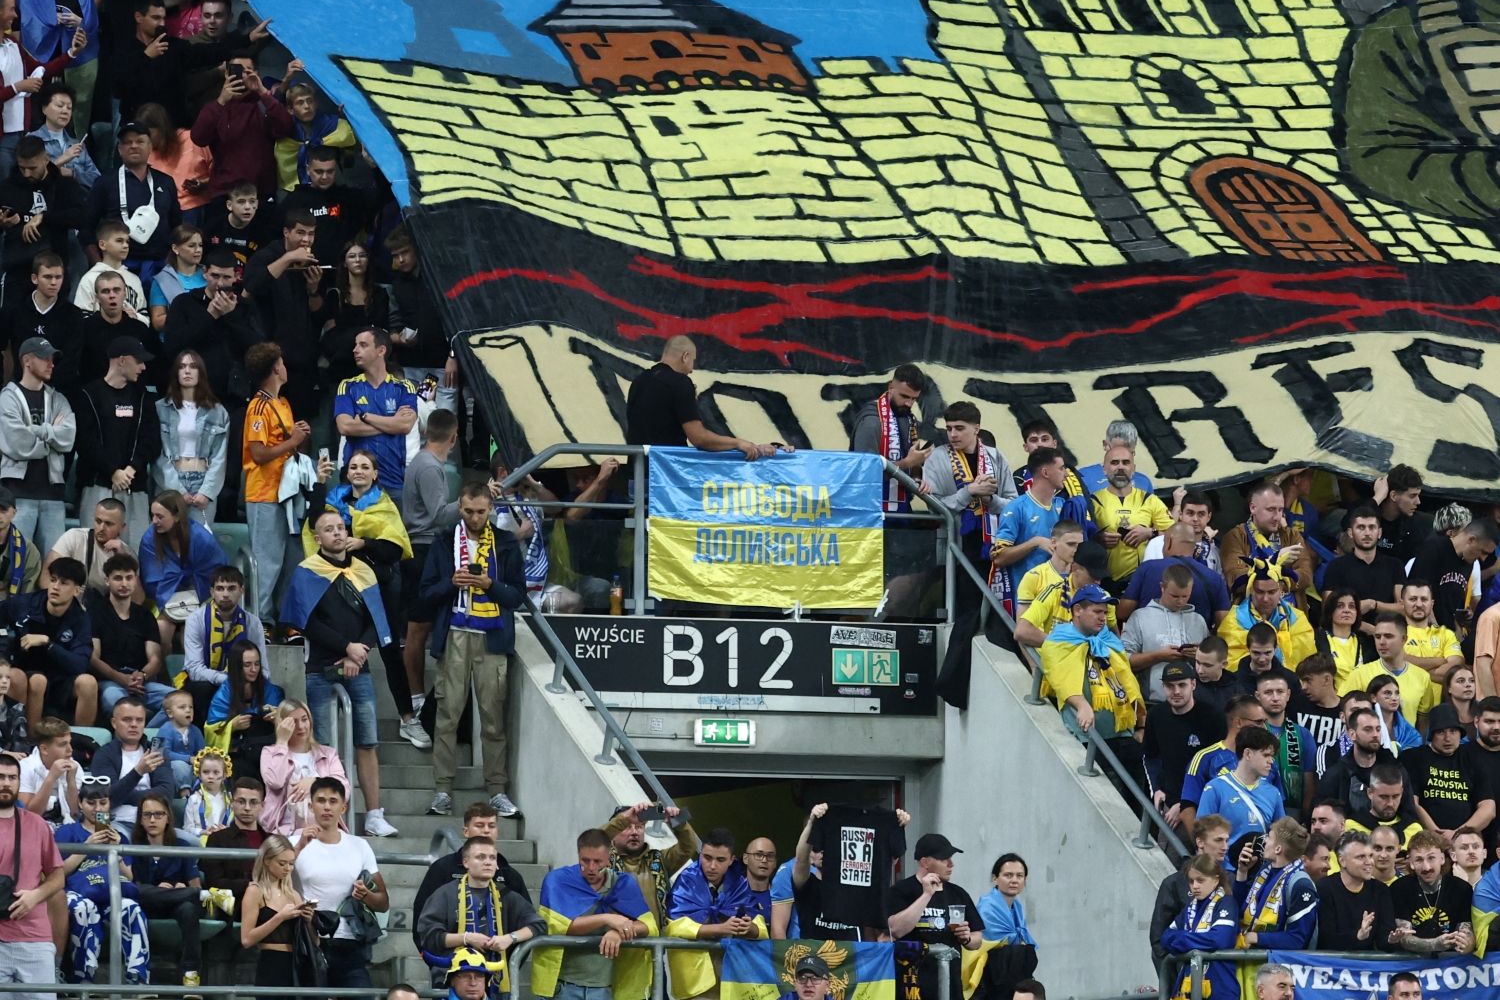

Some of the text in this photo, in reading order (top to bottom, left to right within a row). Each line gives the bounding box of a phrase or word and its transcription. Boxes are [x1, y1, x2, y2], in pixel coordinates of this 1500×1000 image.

[701, 480, 832, 522] СЛОБОДА
[692, 526, 841, 567] ДОЛИНСЬКА
[574, 623, 646, 644] WYJŚCIE
[574, 644, 612, 660] EXIT
[663, 624, 795, 690] B12
[1438, 770, 1461, 780] FREE
[1427, 778, 1469, 791] AZOVSTAL
[1423, 788, 1469, 802] DEFENDER
[842, 829, 874, 844] RUSSIA
[843, 842, 872, 863] IS A
[842, 860, 872, 871] TERRORIST
[842, 868, 871, 883] STATE
[393, 911, 407, 929] 2
